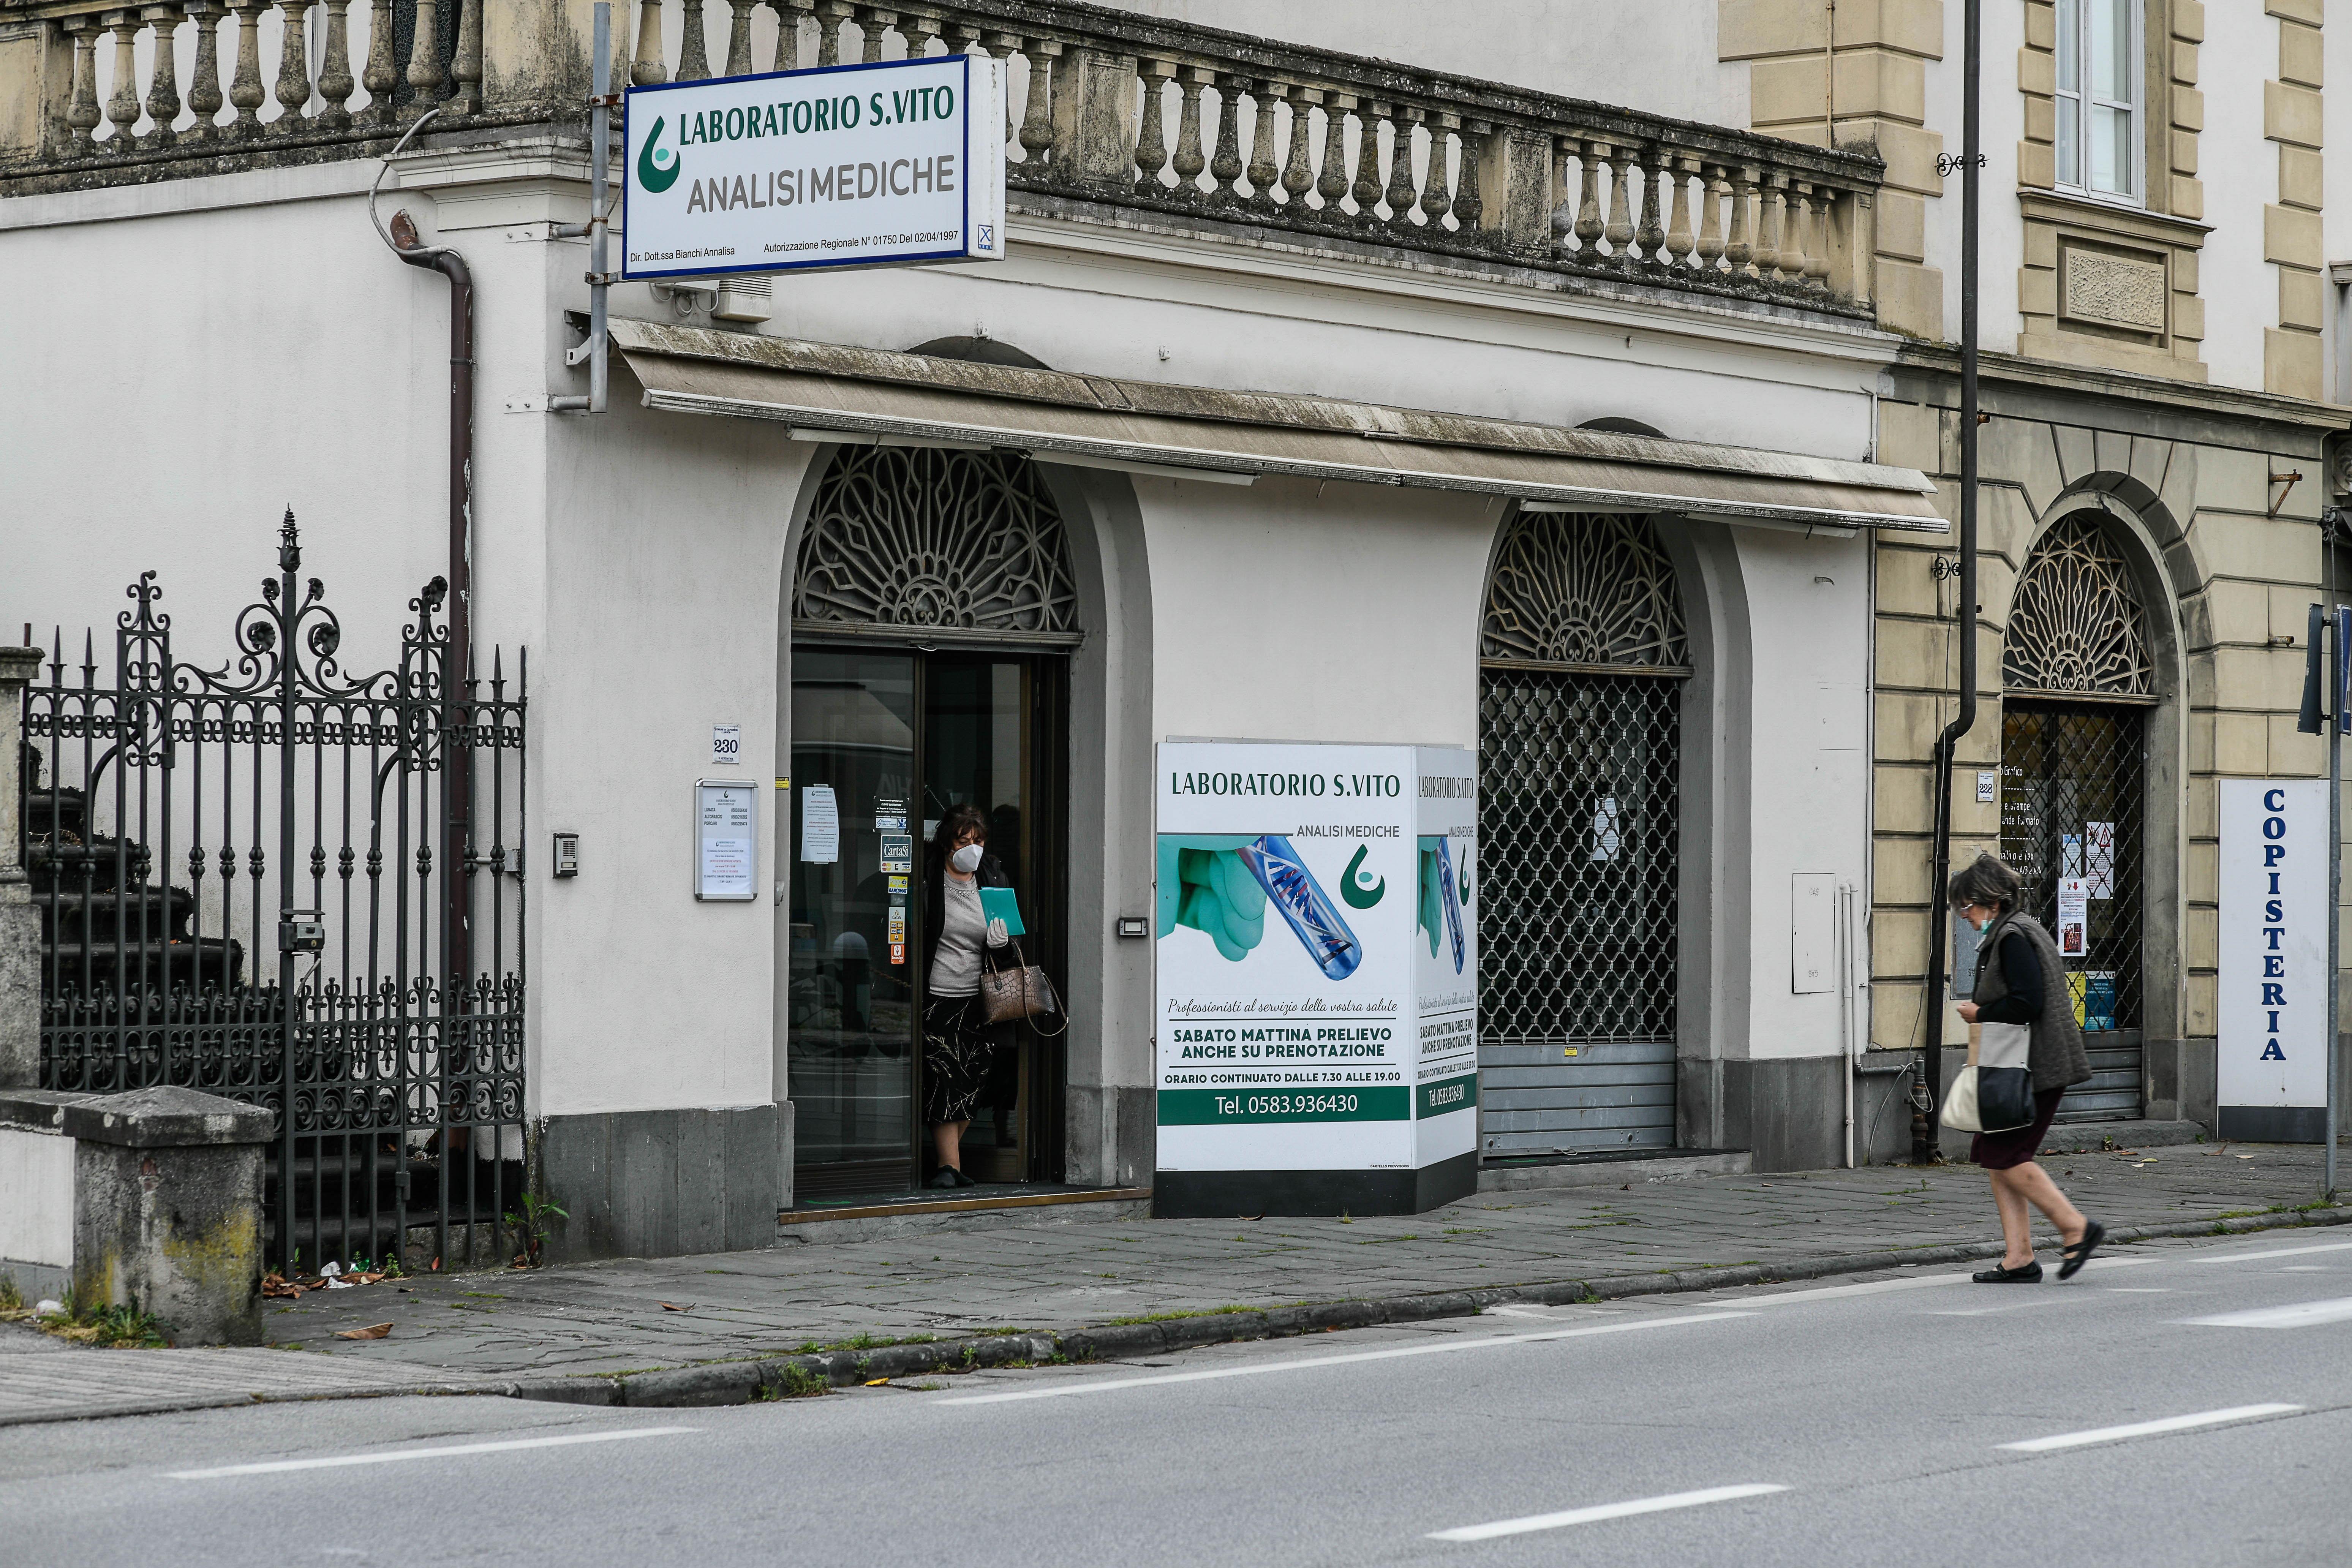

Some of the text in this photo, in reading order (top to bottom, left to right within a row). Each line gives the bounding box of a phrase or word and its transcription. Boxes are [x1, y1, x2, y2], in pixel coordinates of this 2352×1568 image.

[680, 85, 954, 145] LABORATORIO S.VITO
[687, 155, 954, 214] ANALISI MEDICHE
[764, 231, 958, 253] Autorizzazione Regionale N° 01750 Del 02/04/1997
[630, 246, 735, 262] Dir. Dott.ssa Bianchi Annalisa
[714, 739, 738, 753] 230
[1172, 772, 1400, 797] LABORATORIO S.VITO
[1419, 776, 1473, 798] LABORATORIO S.VITO
[1979, 784, 1992, 793] 228
[1297, 825, 1400, 838] ANALISI MEDICHE
[1449, 826, 1473, 838] ANALISI MEDICHE
[2259, 789, 2287, 1061] COPISTERIA
[1168, 998, 1397, 1016] Professionisti al servizio della vostra salute
[1174, 1027, 1392, 1043] SABATO MATTINA PRELIEVO
[1420, 1018, 1473, 1039] SABATO MATTINA PRELIEVO
[1181, 1044, 1385, 1059] ANCHE SU PRENOTAZIONE
[1422, 1034, 1472, 1054] ANCHE SU PRENOTAZIONE
[1165, 1072, 1400, 1084] ORARIO CONTINUATO DALLE 7.30 ALLE 19.00
[1418, 1069, 1429, 1080] ORARIO
[1429, 1065, 1447, 1077] CONTINUATO
[1447, 1064, 1456, 1073] DALLE
[1437, 1084, 1464, 1105] 0583.936430
[1215, 1094, 1358, 1115] Tel. 0583.936430
